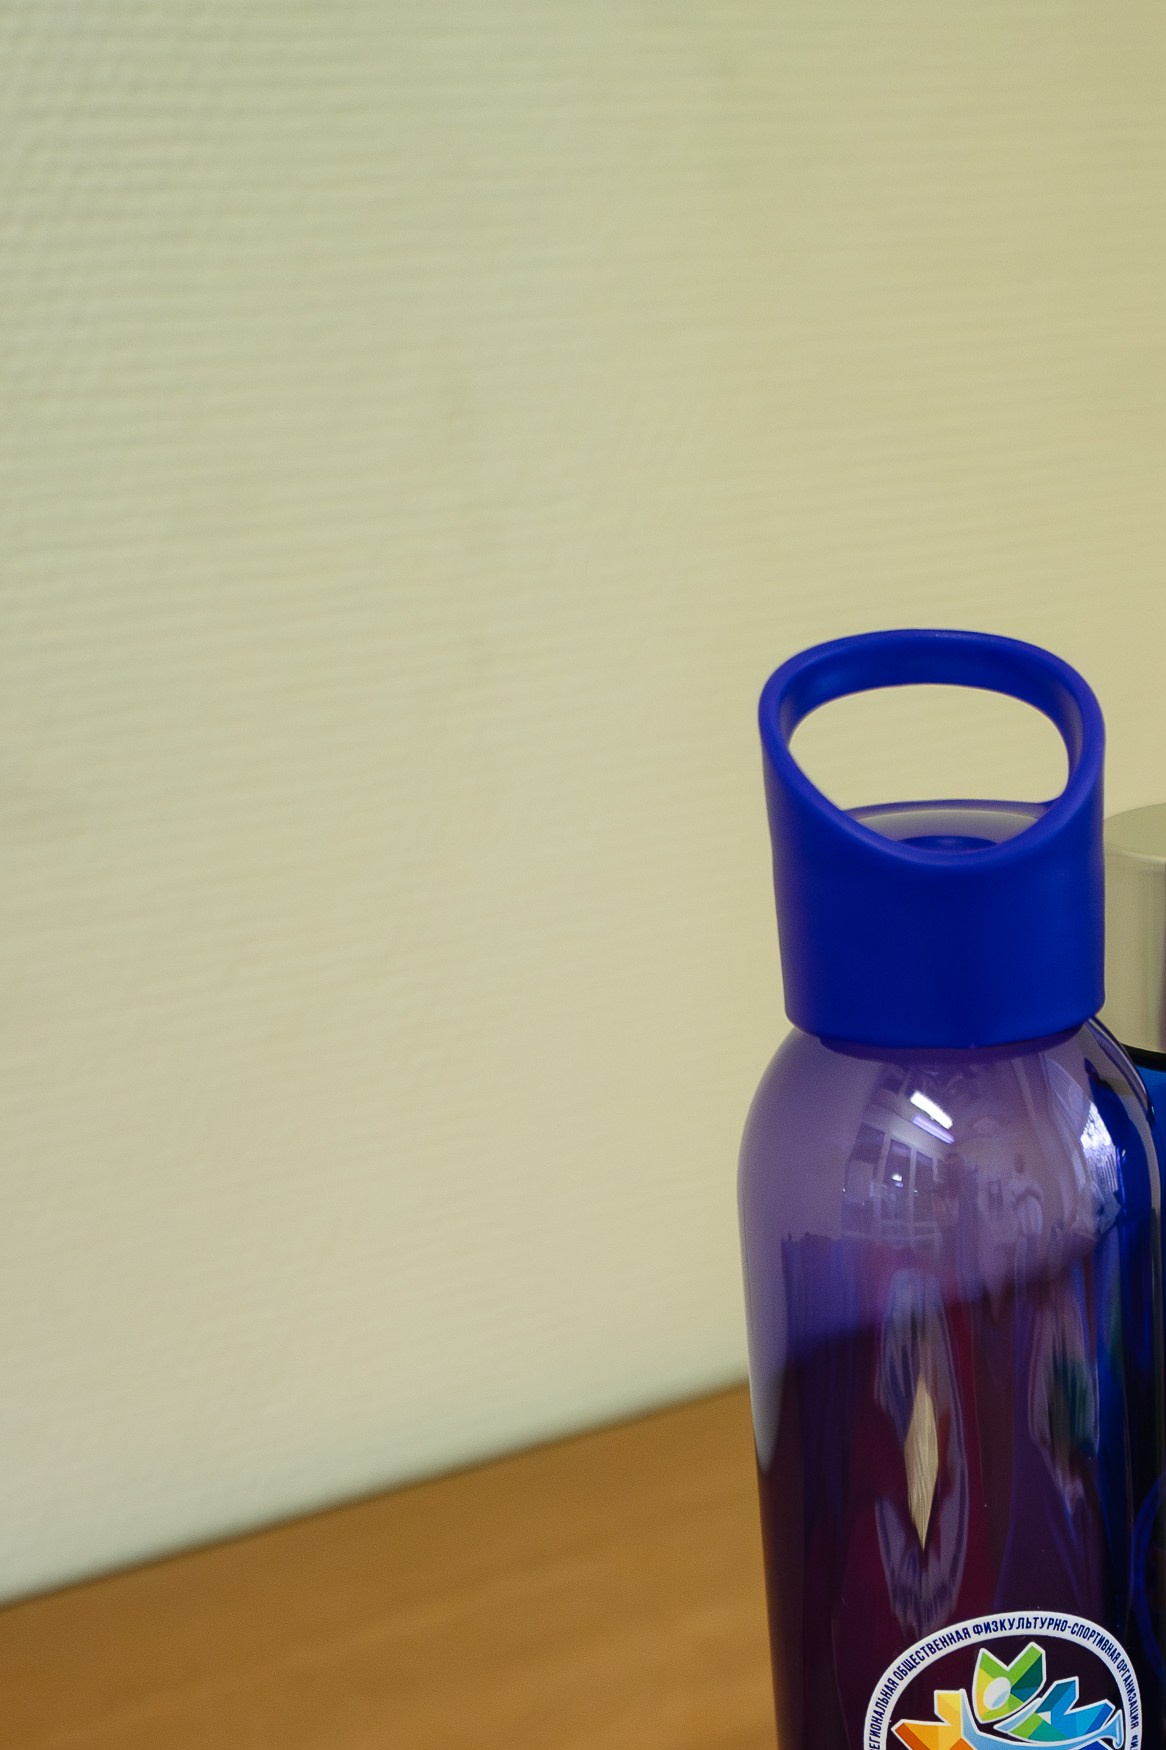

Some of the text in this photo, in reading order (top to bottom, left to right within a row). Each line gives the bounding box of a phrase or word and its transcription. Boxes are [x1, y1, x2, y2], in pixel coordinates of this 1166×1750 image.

[893, 1627, 972, 1682] ОБЩЕСТВЕННАЯ
[973, 1616, 1122, 1665] ФИЗКУЛЬТУРНО-СПОРТИВНАЯ
[1116, 1658, 1140, 1730] ОРГАНИЗАЦИЯ
